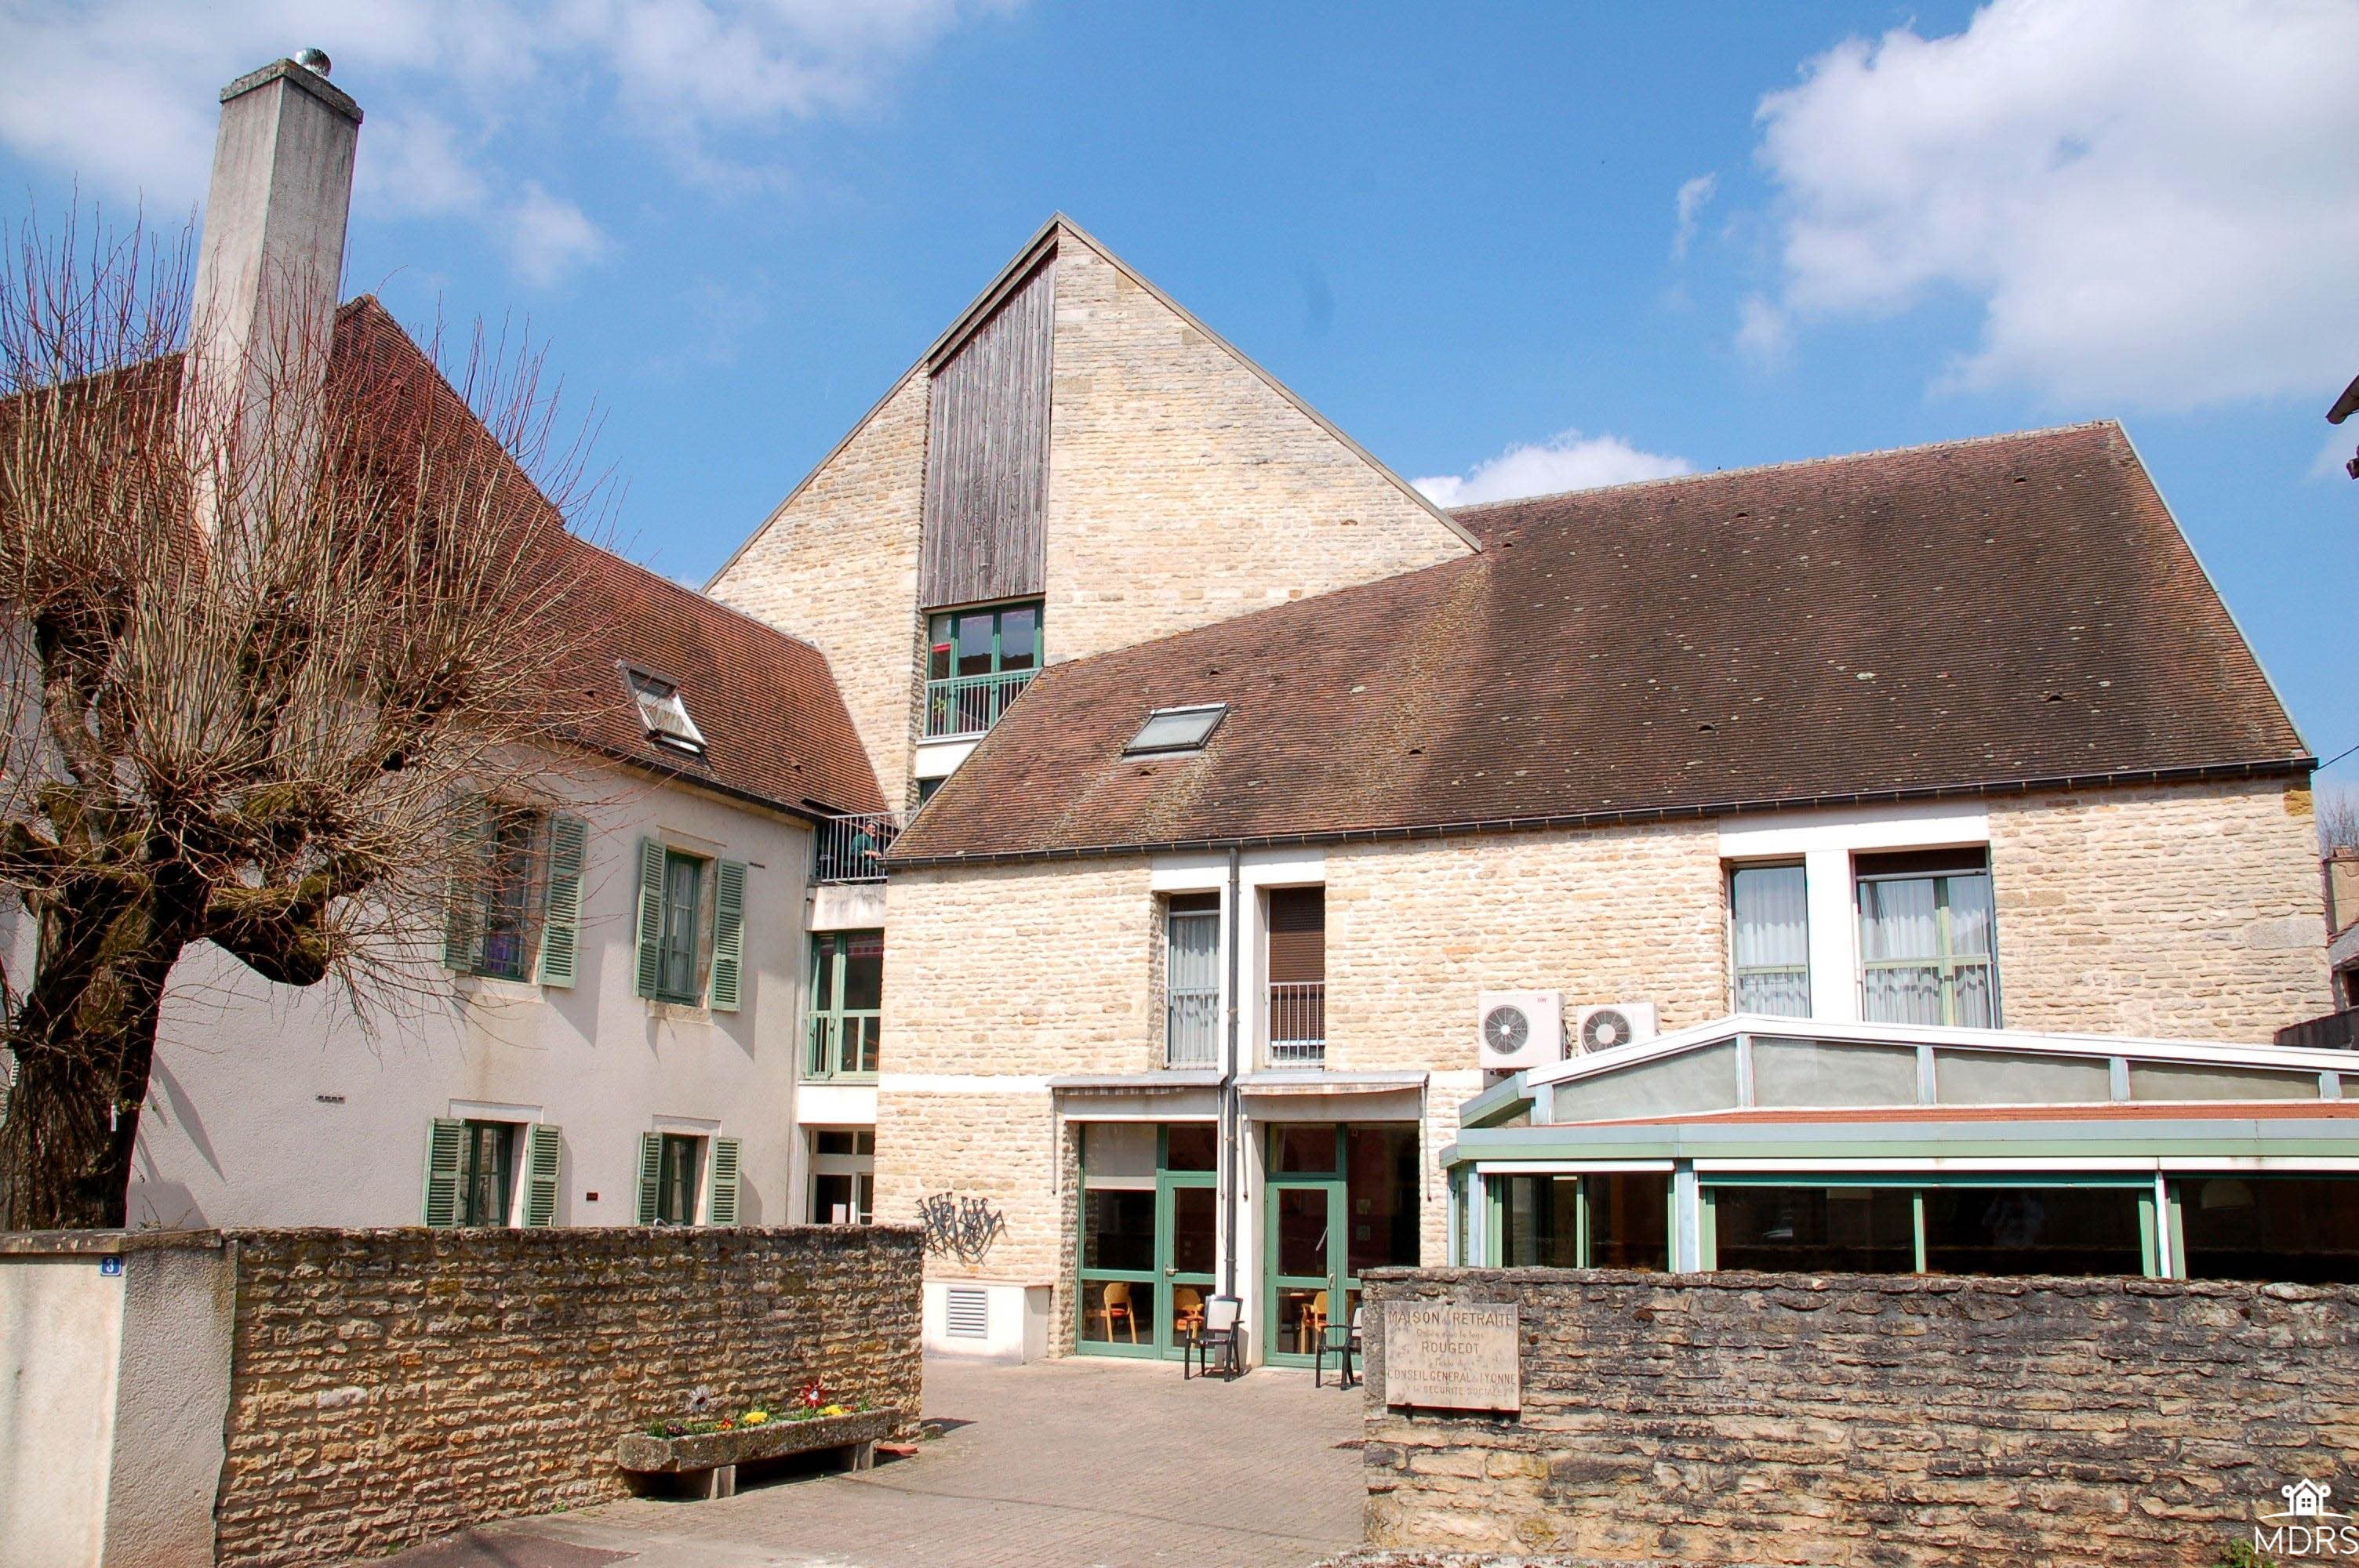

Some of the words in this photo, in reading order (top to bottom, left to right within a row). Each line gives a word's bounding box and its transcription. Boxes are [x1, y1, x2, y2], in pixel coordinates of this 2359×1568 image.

[106, 1258, 114, 1273] 3
[1388, 1310, 1441, 1324] MAISON
[1452, 1312, 1512, 1327] RETRAITE
[1421, 1341, 1481, 1356] ROUGEOT
[1387, 1368, 1428, 1381] CONSEIL
